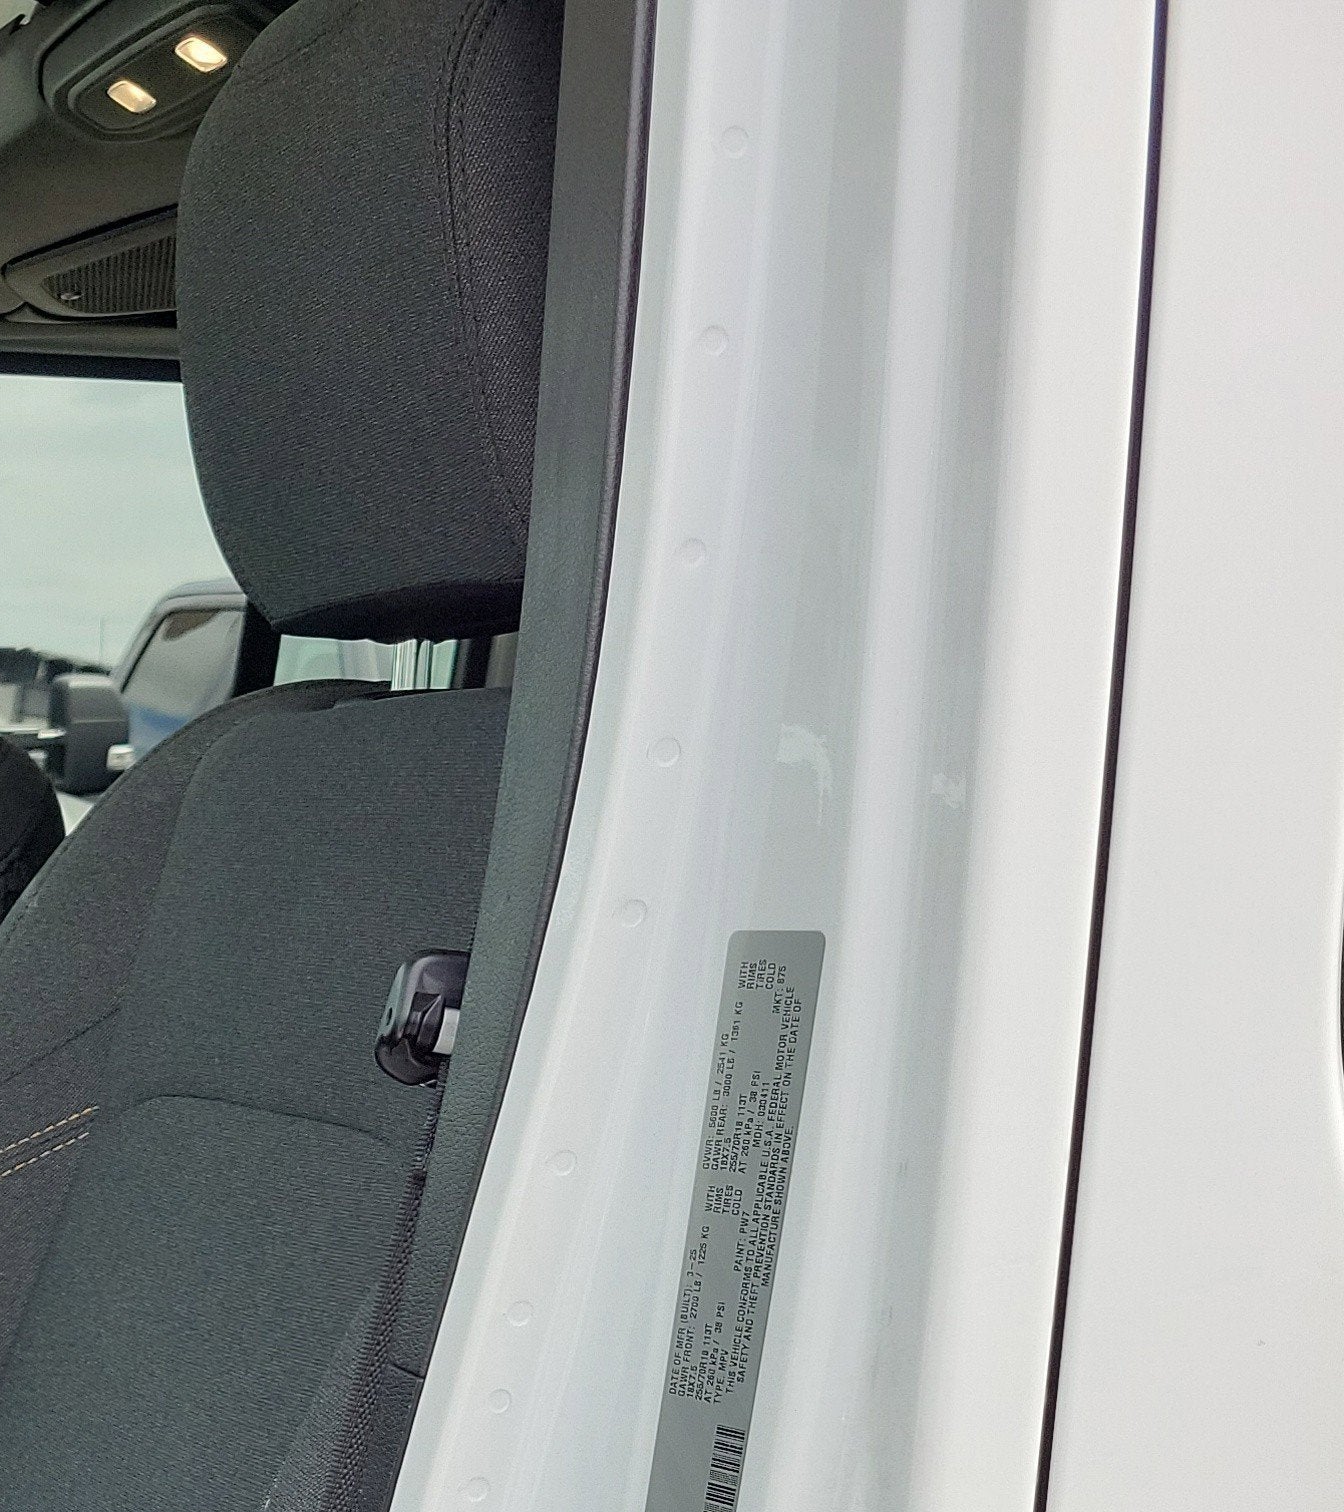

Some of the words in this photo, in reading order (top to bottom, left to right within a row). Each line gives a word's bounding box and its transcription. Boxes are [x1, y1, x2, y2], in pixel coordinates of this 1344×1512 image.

[737, 961, 748, 988] WITH
[746, 962, 757, 989] RIMS
[755, 958, 767, 989] TIRES
[764, 962, 776, 989] COLD
[734, 1001, 743, 1014] KG
[779, 986, 794, 1030] VEHICLE
[792, 998, 802, 1012] OF
[787, 1015, 799, 1043] DATE
[774, 1034, 787, 1070] MOTOR
[784, 1047, 795, 1068] THE
[712, 1089, 720, 1100] LB
[720, 1033, 729, 1046] KG
[781, 1071, 791, 1086] ON
[721, 1073, 732, 1096] 3000
[766, 1074, 782, 1121] FEDERAL
[775, 1089, 789, 1128] EFFECT
[743, 1117, 753, 1135] kPa
[773, 1132, 782, 1143] IN
[710, 1139, 722, 1170] GAWR
[740, 1138, 750, 1156] 260
[737, 1160, 746, 1173] AT
[762, 1147, 780, 1210] STANDARDS
[704, 1185, 715, 1212] WITH
[721, 1184, 733, 1214] TIRES
[731, 1189, 742, 1215] COLD
[751, 1161, 768, 1223] APPLICABLE
[700, 1225, 709, 1238] KG
[748, 1226, 758, 1246] ALL
[760, 1208, 780, 1287] MANUFACTURE
[773, 1166, 787, 1205] SHOWN
[696, 1241, 707, 1264] 1225
[745, 1249, 754, 1261] TO
[752, 1213, 770, 1278] PREVENTION
[686, 1364, 697, 1398] 18X7.5
[712, 1187, 723, 1213] RIMS
[692, 1280, 701, 1291] LB
[718, 1348, 728, 1371] MPV
[739, 1210, 750, 1233] PW7
[736, 1265, 752, 1322] CONFORMS
[747, 1282, 759, 1315] THEFT
[689, 1295, 699, 1318] 2700
[716, 1301, 725, 1317] PSI
[675, 1327, 685, 1349] MFR
[714, 1321, 722, 1333] 38
[743, 1318, 753, 1341] AND
[682, 1325, 695, 1362] FRONT:
[709, 1346, 718, 1365] kPa
[729, 1325, 743, 1368] VEHICLE
[673, 1351, 682, 1365] OF
[736, 1343, 749, 1382] SAFETY
[668, 1367, 679, 1394] DATE
[677, 1365, 688, 1397] GAWR
[706, 1368, 715, 1386] 260
[725, 1370, 736, 1394] THIS
[703, 1389, 712, 1402] AT
